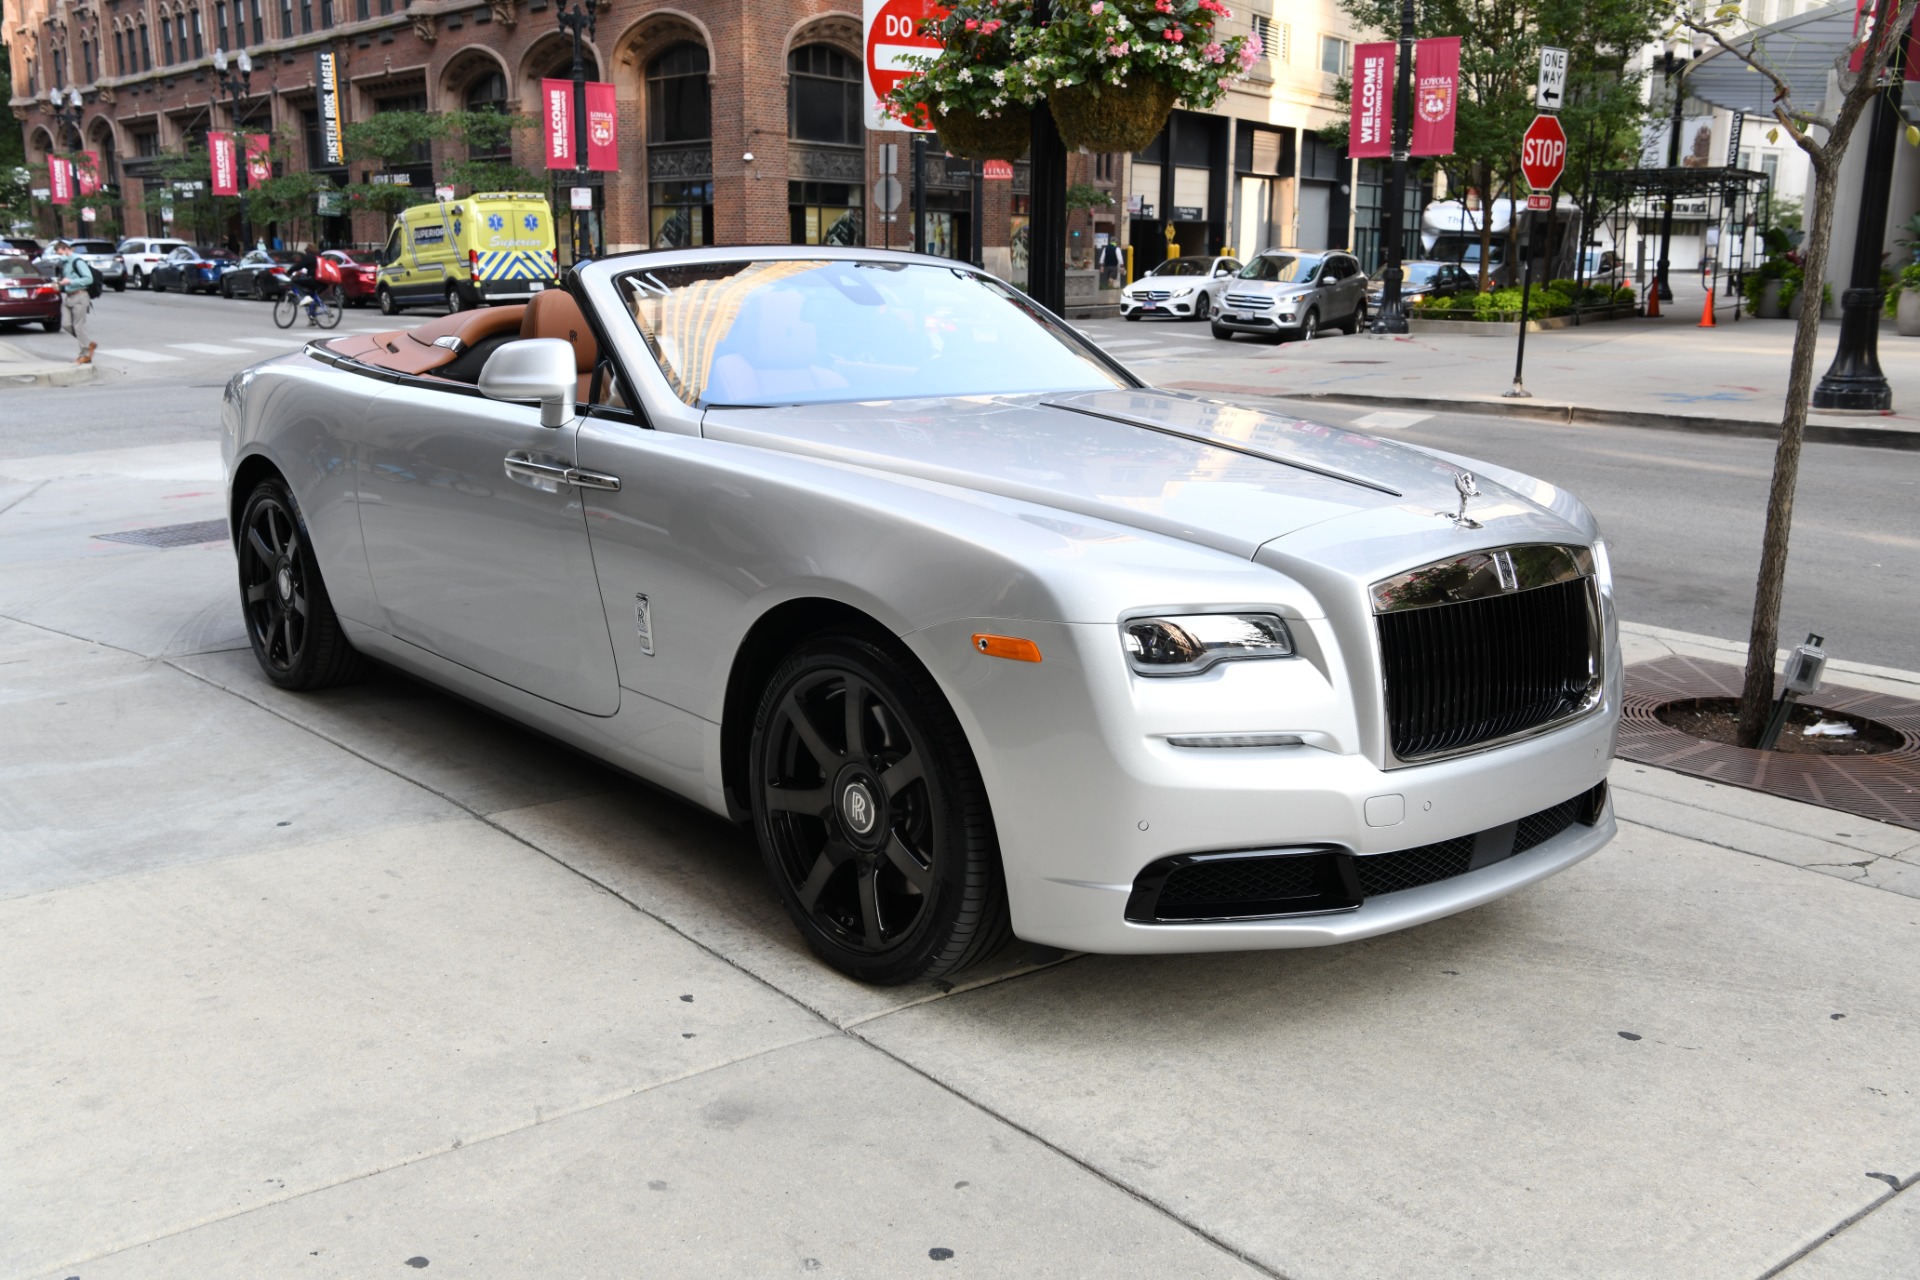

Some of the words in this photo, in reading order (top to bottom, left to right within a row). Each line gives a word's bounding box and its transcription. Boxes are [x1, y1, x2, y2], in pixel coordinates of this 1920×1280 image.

[886, 14, 913, 38] DO
[320, 53, 334, 91] BAGELS
[1376, 57, 1385, 90] CAMPUS
[1544, 53, 1564, 69] ONE
[1420, 77, 1452, 86] LOYOLA
[1542, 70, 1563, 86] WAY
[1360, 57, 1377, 144] WELCOME
[1375, 90, 1383, 117] TOWER
[551, 90, 563, 158] WELCOME
[590, 111, 613, 119] LOYOLA
[326, 120, 339, 163] EINSTEIN
[1373, 117, 1381, 144] WATER
[1728, 113, 1742, 165] ORDSTROM
[215, 139, 226, 188] WELCOME
[1524, 138, 1564, 167] STOP
[983, 167, 1013, 177] LUMA
[1529, 198, 1539, 207] ALL
[1539, 198, 1549, 208] WAY
[413, 226, 444, 239] SUPERIOR
[489, 235, 542, 248] Superior
